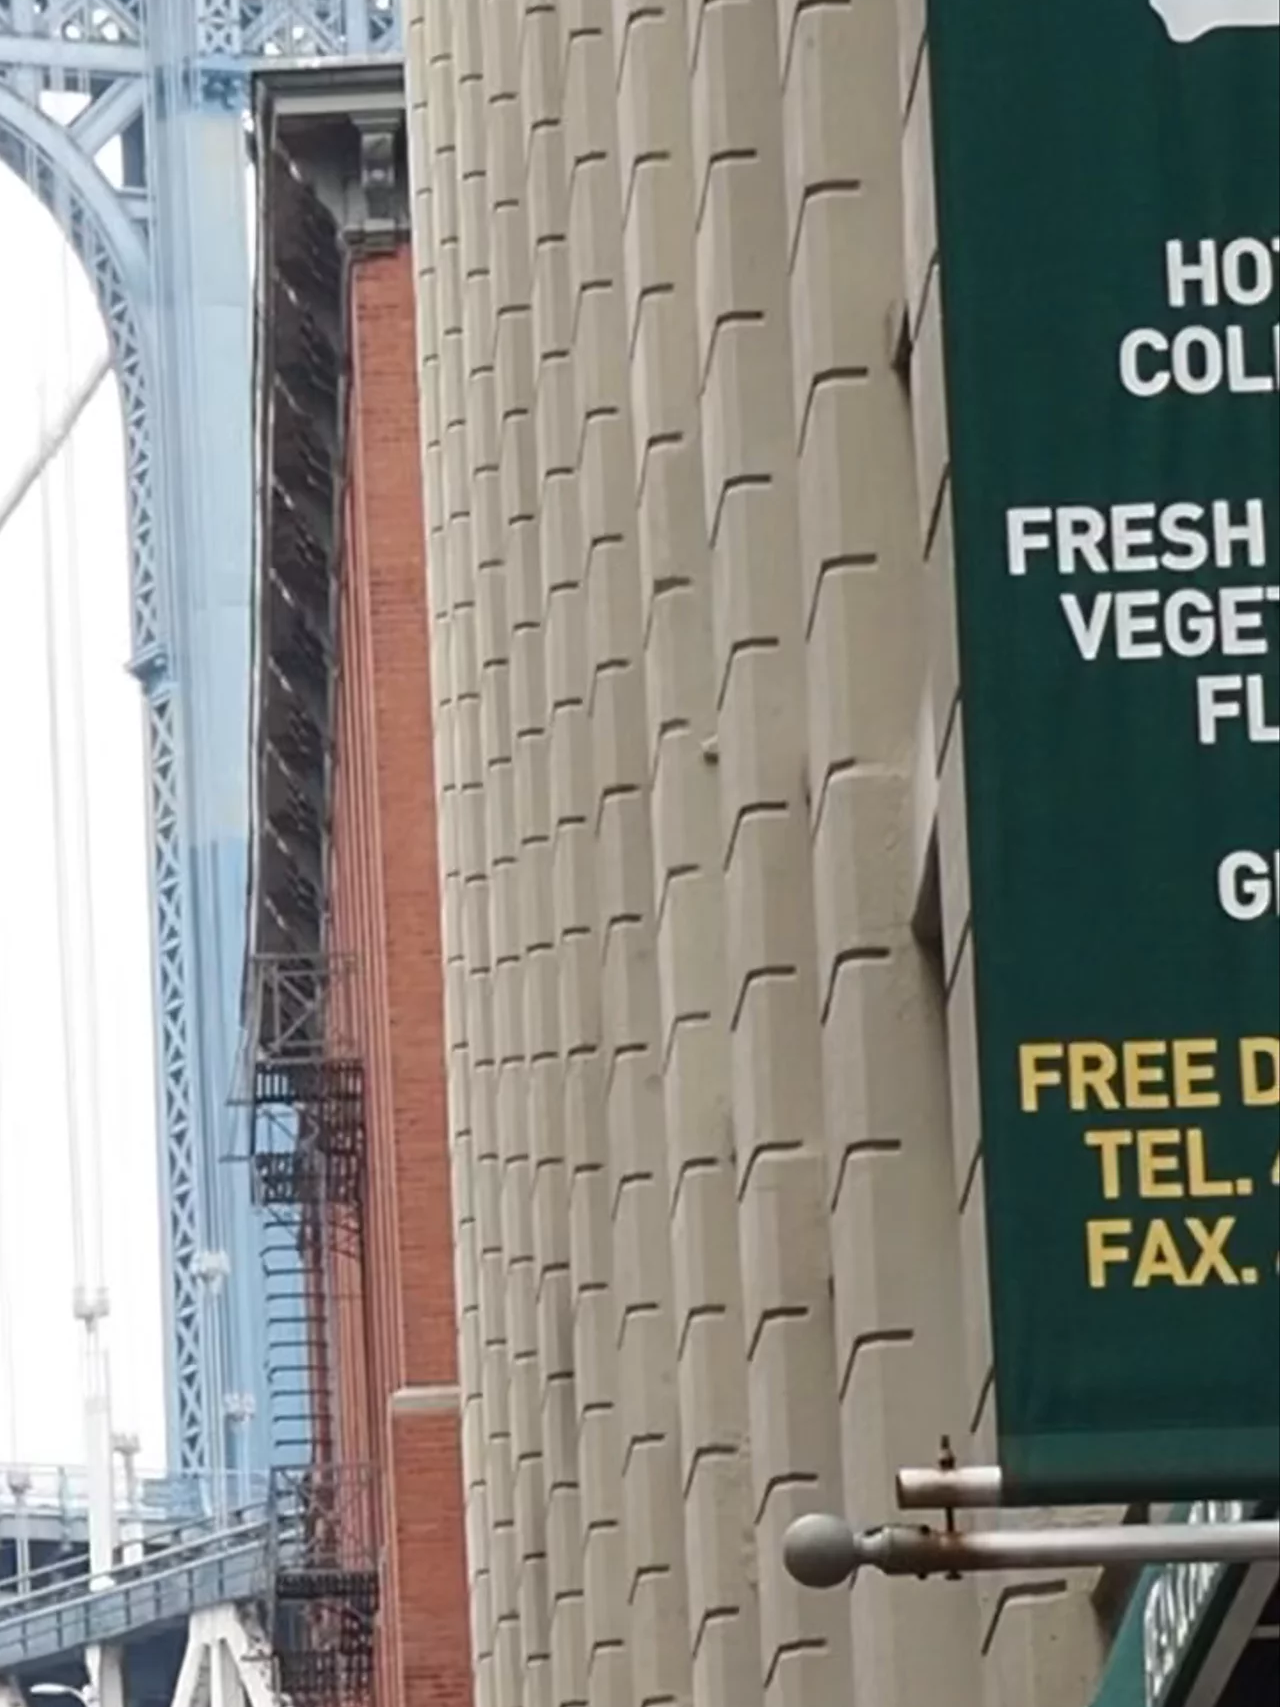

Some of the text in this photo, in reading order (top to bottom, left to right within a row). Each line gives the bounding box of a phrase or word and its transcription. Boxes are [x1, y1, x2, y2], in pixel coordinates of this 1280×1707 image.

[1166, 237, 1280, 307] HO
[1119, 324, 1280, 397] COL
[1006, 498, 1266, 575] FRESH
[1218, 849, 1280, 920] G
[1019, 1038, 1221, 1112] FREE
[1084, 1128, 1253, 1199] TEL.
[1086, 1216, 1259, 1288] FAX.
